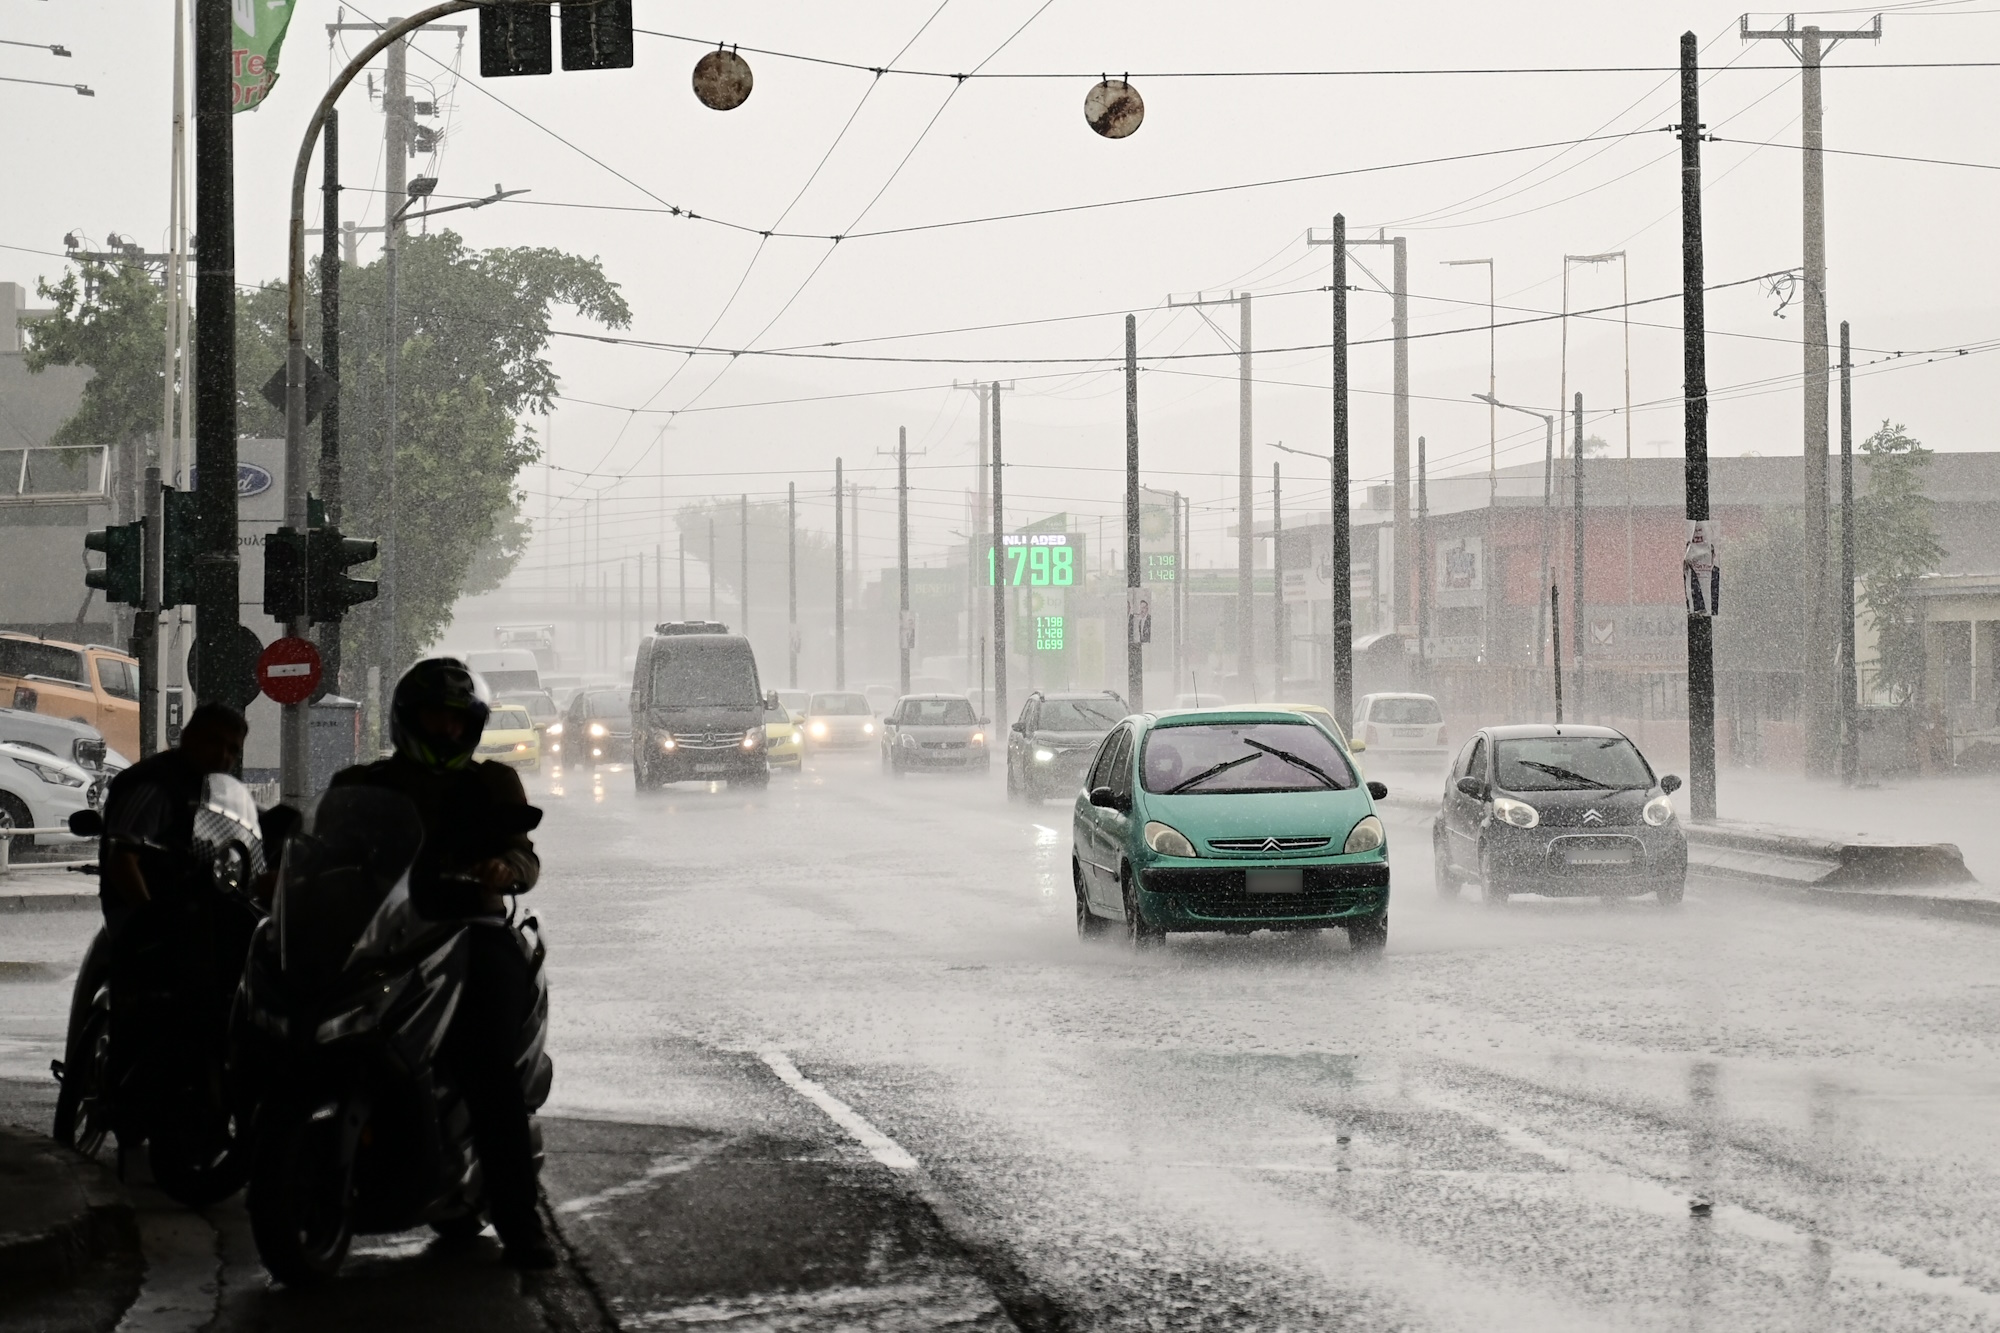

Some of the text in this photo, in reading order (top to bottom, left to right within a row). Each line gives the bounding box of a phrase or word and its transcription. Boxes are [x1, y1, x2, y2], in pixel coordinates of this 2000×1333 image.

[987, 546, 1072, 586] 1.798
[1148, 555, 1175, 566] 1.798
[1148, 569, 1175, 580] 1.428
[1036, 616, 1063, 628] 1.798
[1036, 627, 1063, 639] 1.428
[1036, 639, 1063, 650] 0.699
